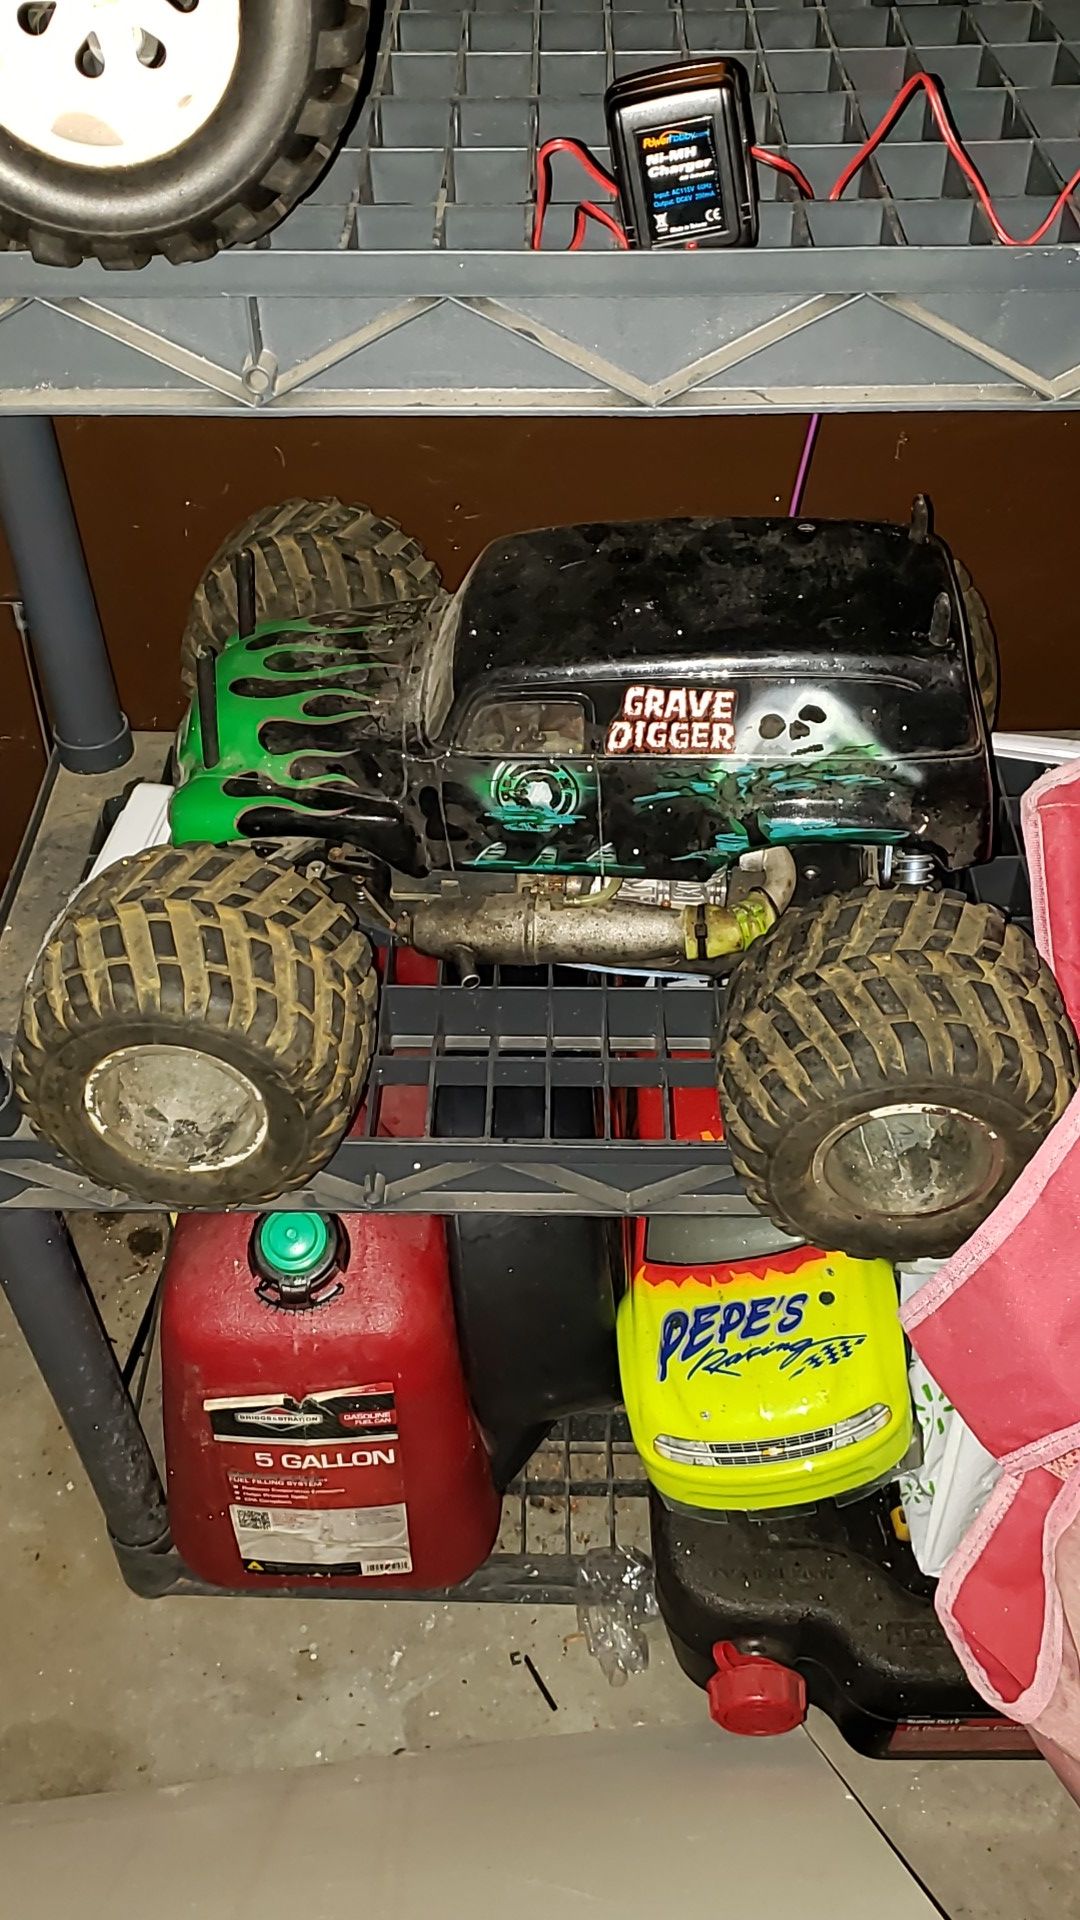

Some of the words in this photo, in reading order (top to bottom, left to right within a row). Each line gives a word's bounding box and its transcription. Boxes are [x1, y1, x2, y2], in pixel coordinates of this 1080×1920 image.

[646, 145, 698, 167] Ni-MH
[647, 157, 713, 179] Charger
[623, 686, 735, 720] GRAVE
[606, 721, 736, 751] DIGGER
[659, 1293, 809, 1382] PEPE'S
[687, 1334, 860, 1380] Racing
[343, 1411, 391, 1421] GASOLINE
[254, 1452, 274, 1467] 5
[281, 1449, 395, 1469] GALLON
[252, 1478, 284, 1486] FILLING
